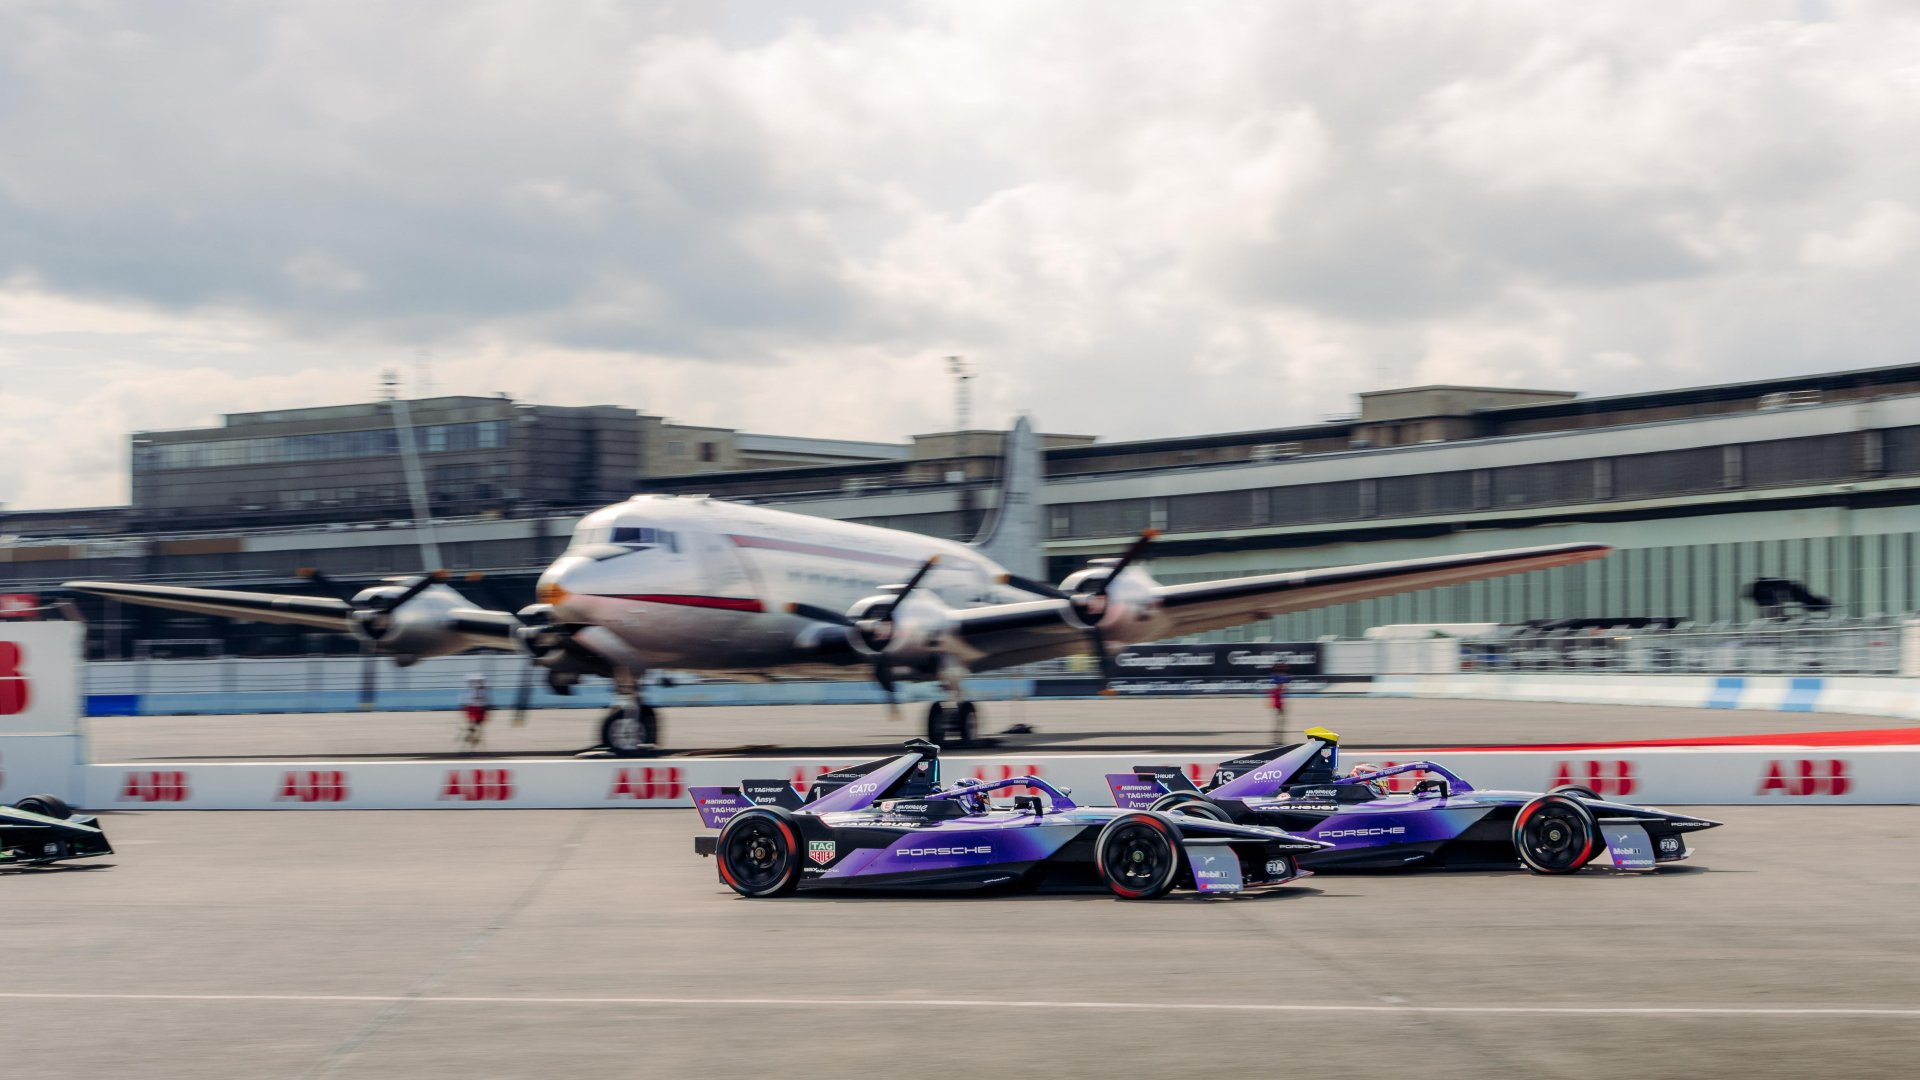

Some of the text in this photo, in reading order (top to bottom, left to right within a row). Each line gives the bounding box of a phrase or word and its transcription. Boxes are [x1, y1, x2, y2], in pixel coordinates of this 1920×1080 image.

[1216, 771, 1235, 785] 13
[1253, 770, 1282, 781] CATO
[1757, 760, 1853, 796] ABB
[119, 771, 189, 801] ABB
[277, 771, 351, 801] ABB
[439, 769, 515, 801] ABB
[609, 767, 686, 800] ABB
[849, 782, 877, 794] CATO
[1129, 801, 1152, 809] Ansy
[1319, 826, 1405, 838] PORSCHE
[811, 842, 833, 850] TAG
[896, 846, 992, 857] PORSCHE
[1661, 841, 1678, 850] FIA
[810, 850, 834, 863] HEUER
[1267, 862, 1285, 872] FIA
